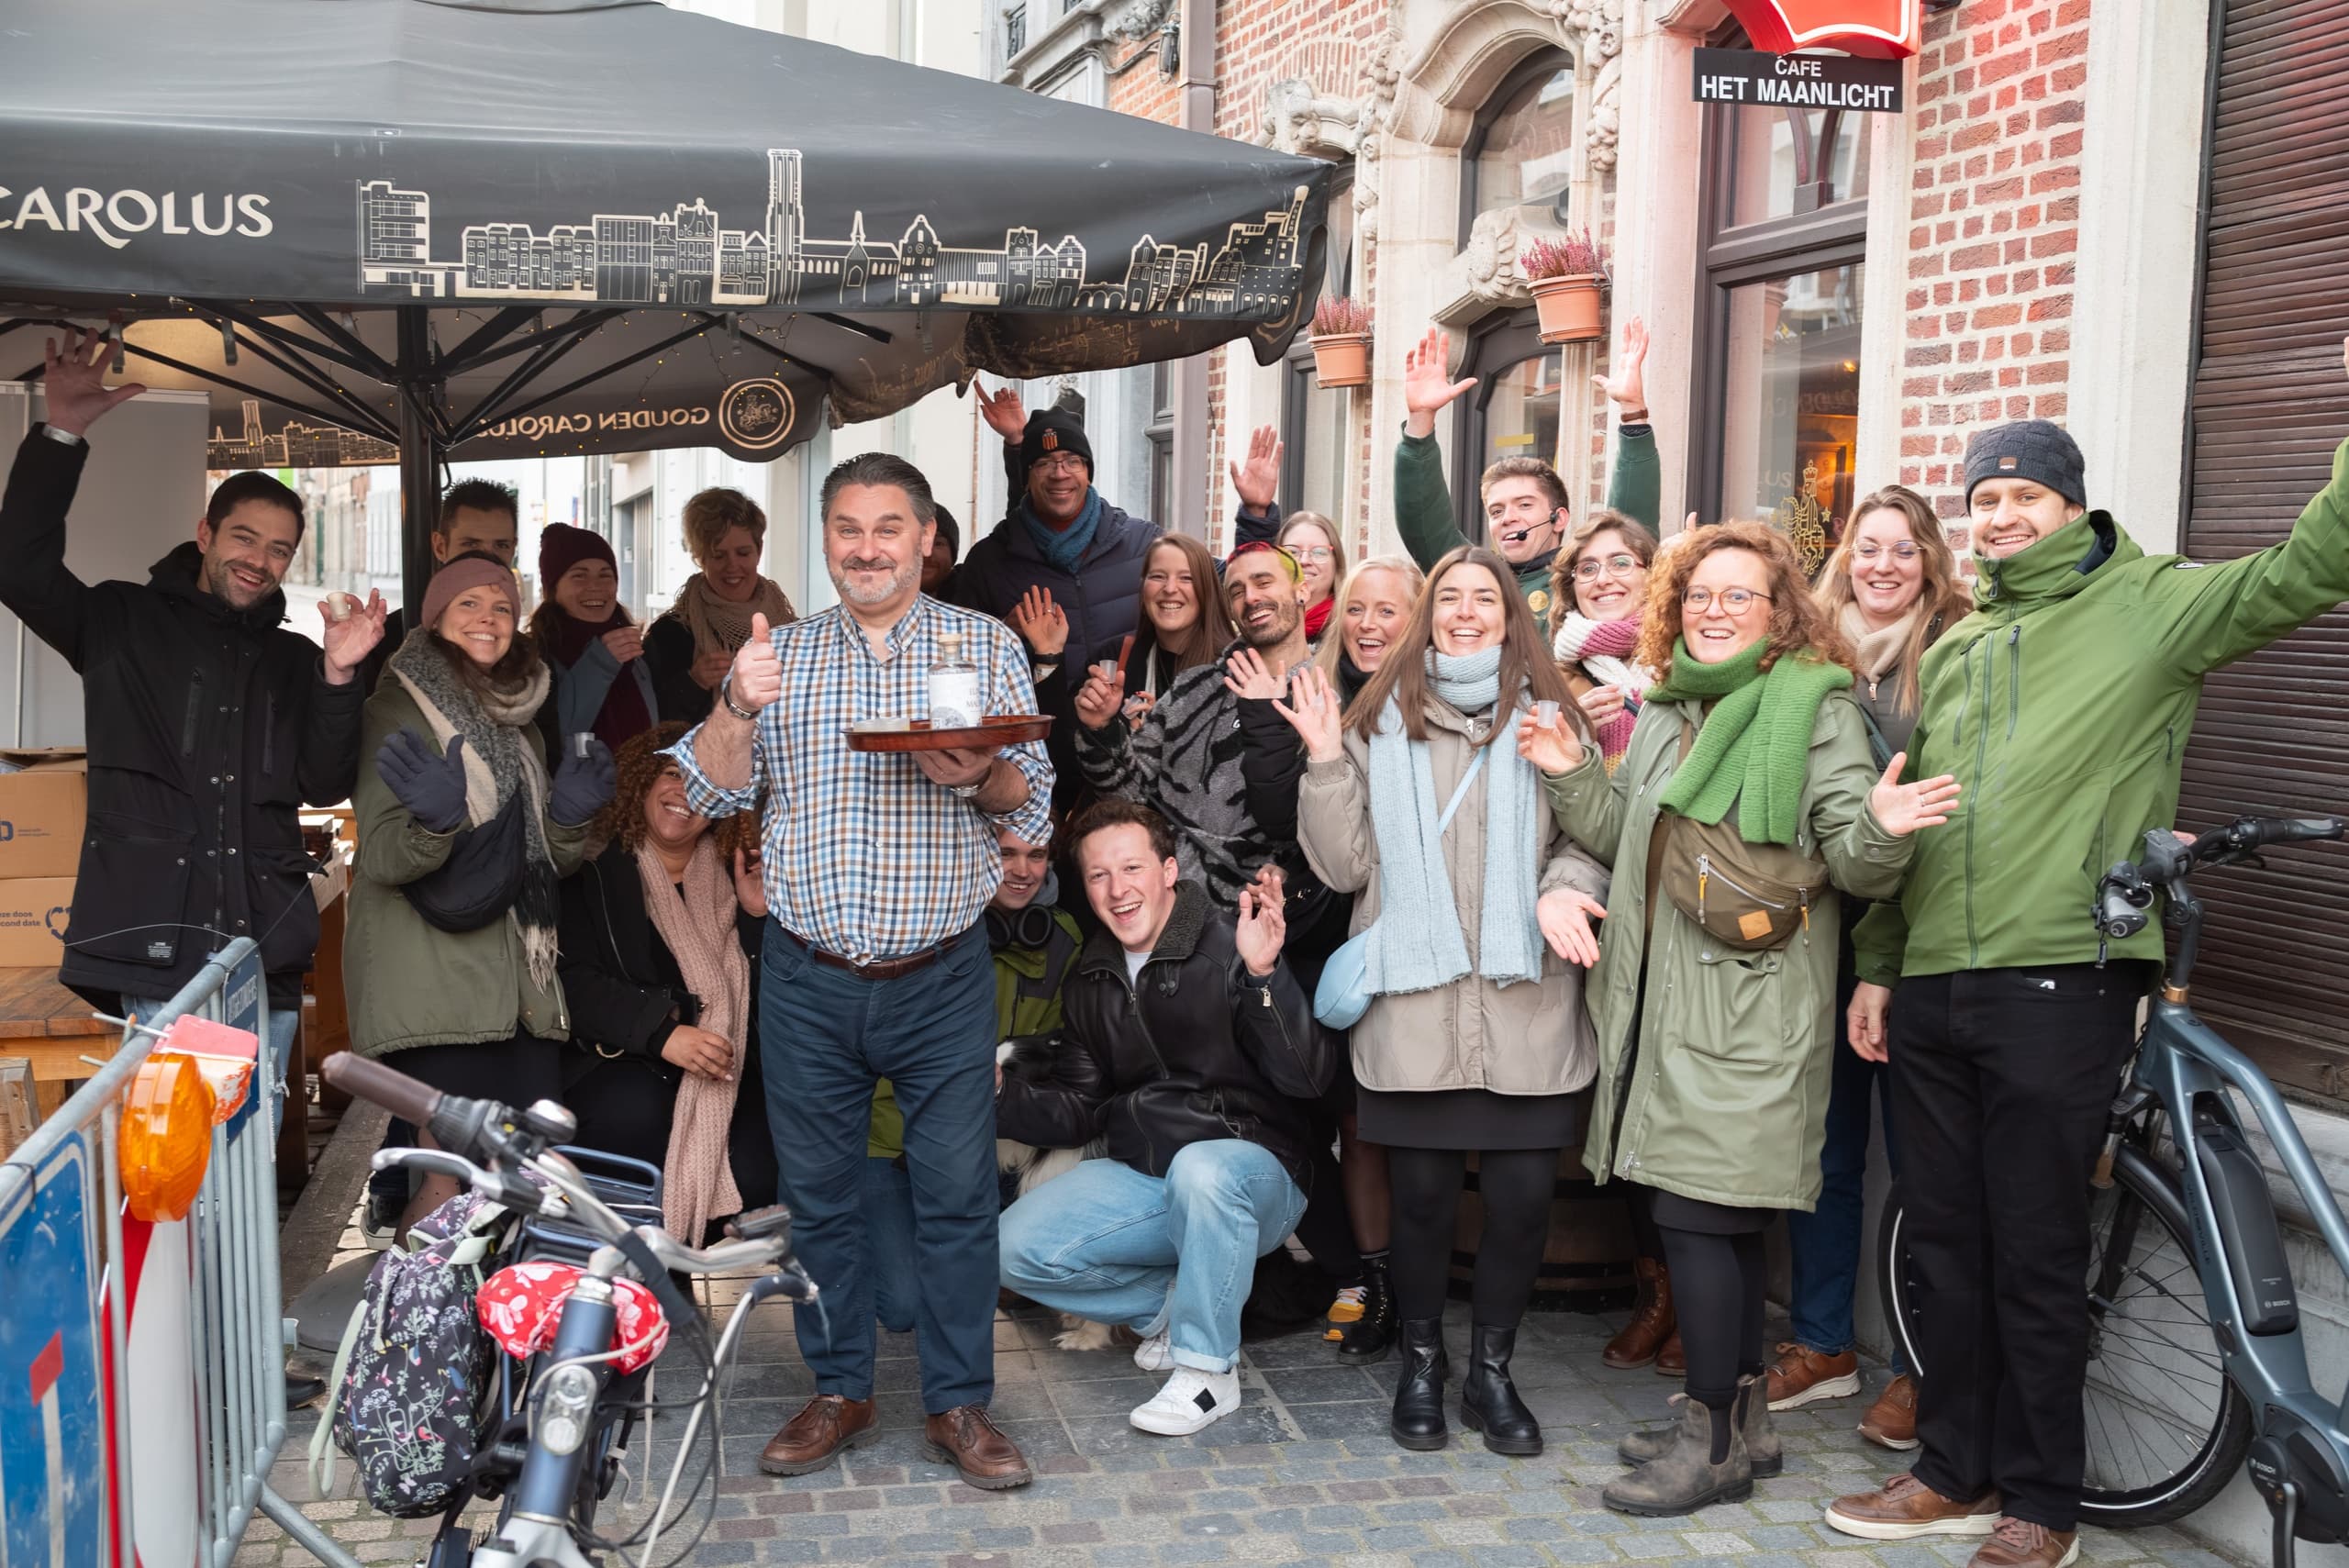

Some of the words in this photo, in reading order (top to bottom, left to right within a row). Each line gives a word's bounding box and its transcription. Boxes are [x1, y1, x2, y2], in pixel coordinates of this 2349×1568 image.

[1775, 59, 1822, 77] CAFE
[1701, 75, 1748, 100] HET
[1757, 78, 1894, 108] MAANLICHT
